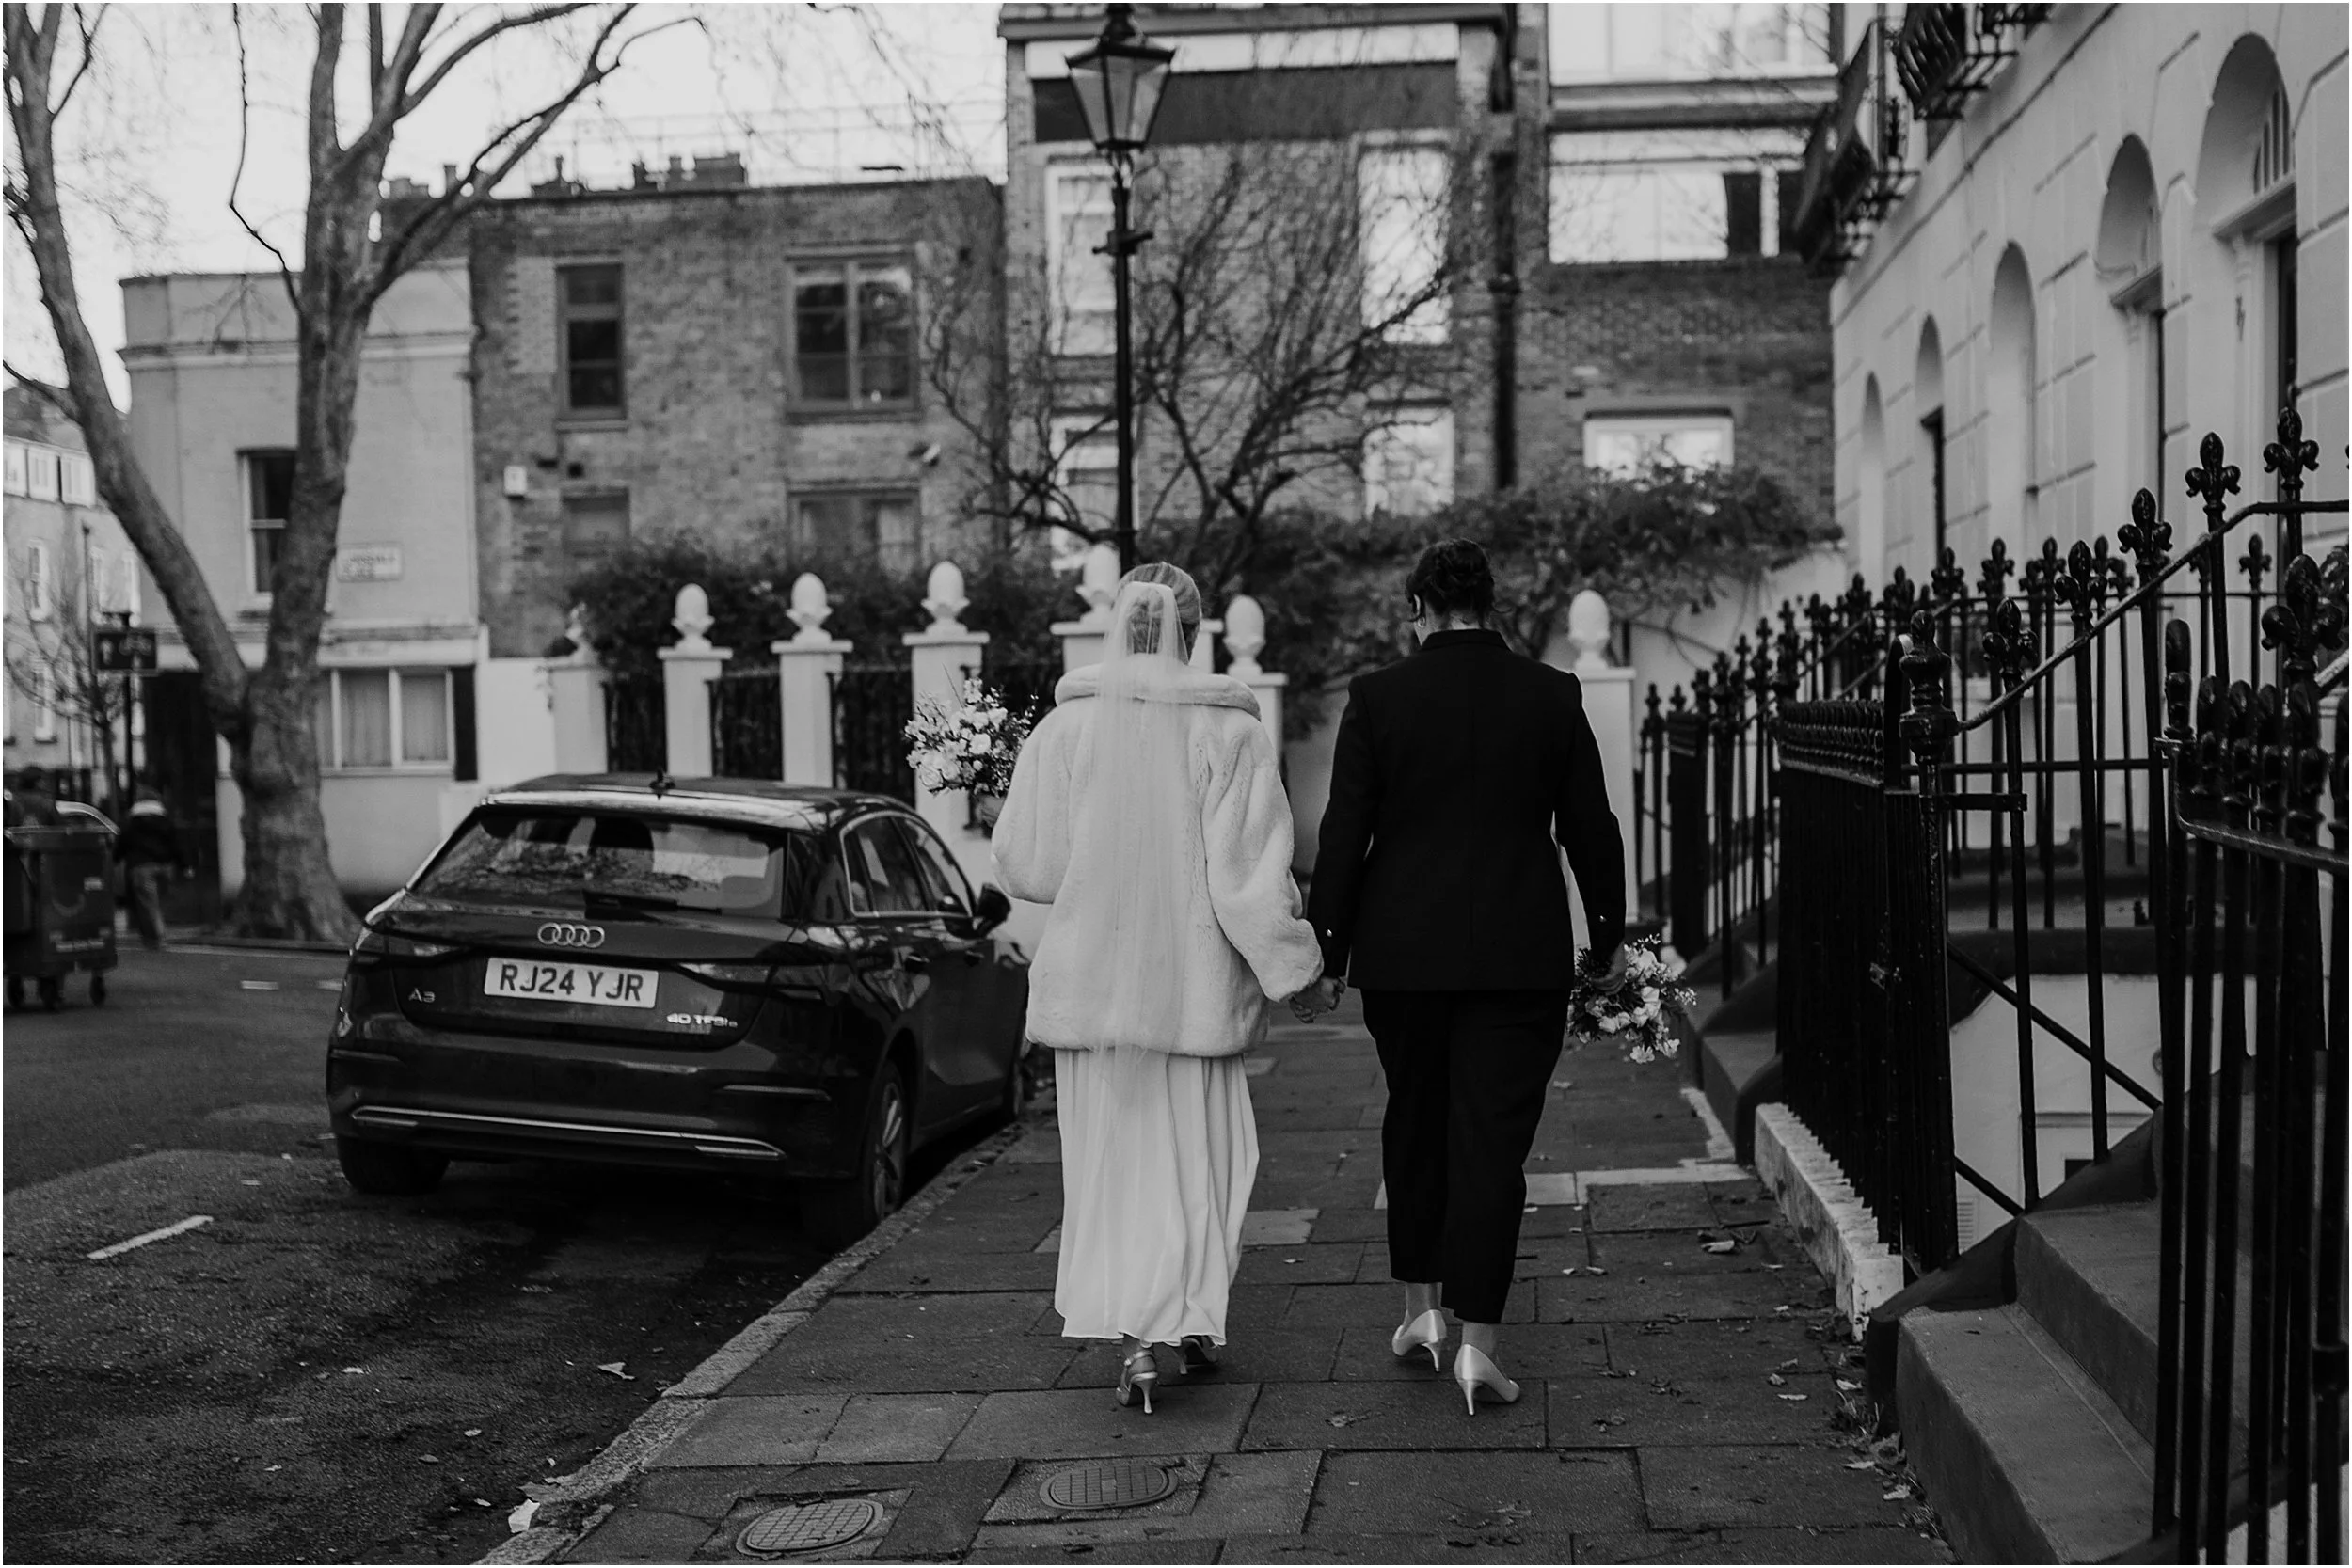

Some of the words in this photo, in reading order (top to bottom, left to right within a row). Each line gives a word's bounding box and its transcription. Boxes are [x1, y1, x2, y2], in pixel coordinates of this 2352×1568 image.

[408, 988, 435, 1003] A3
[500, 964, 575, 996] RJ24
[587, 970, 644, 1002] YJR
